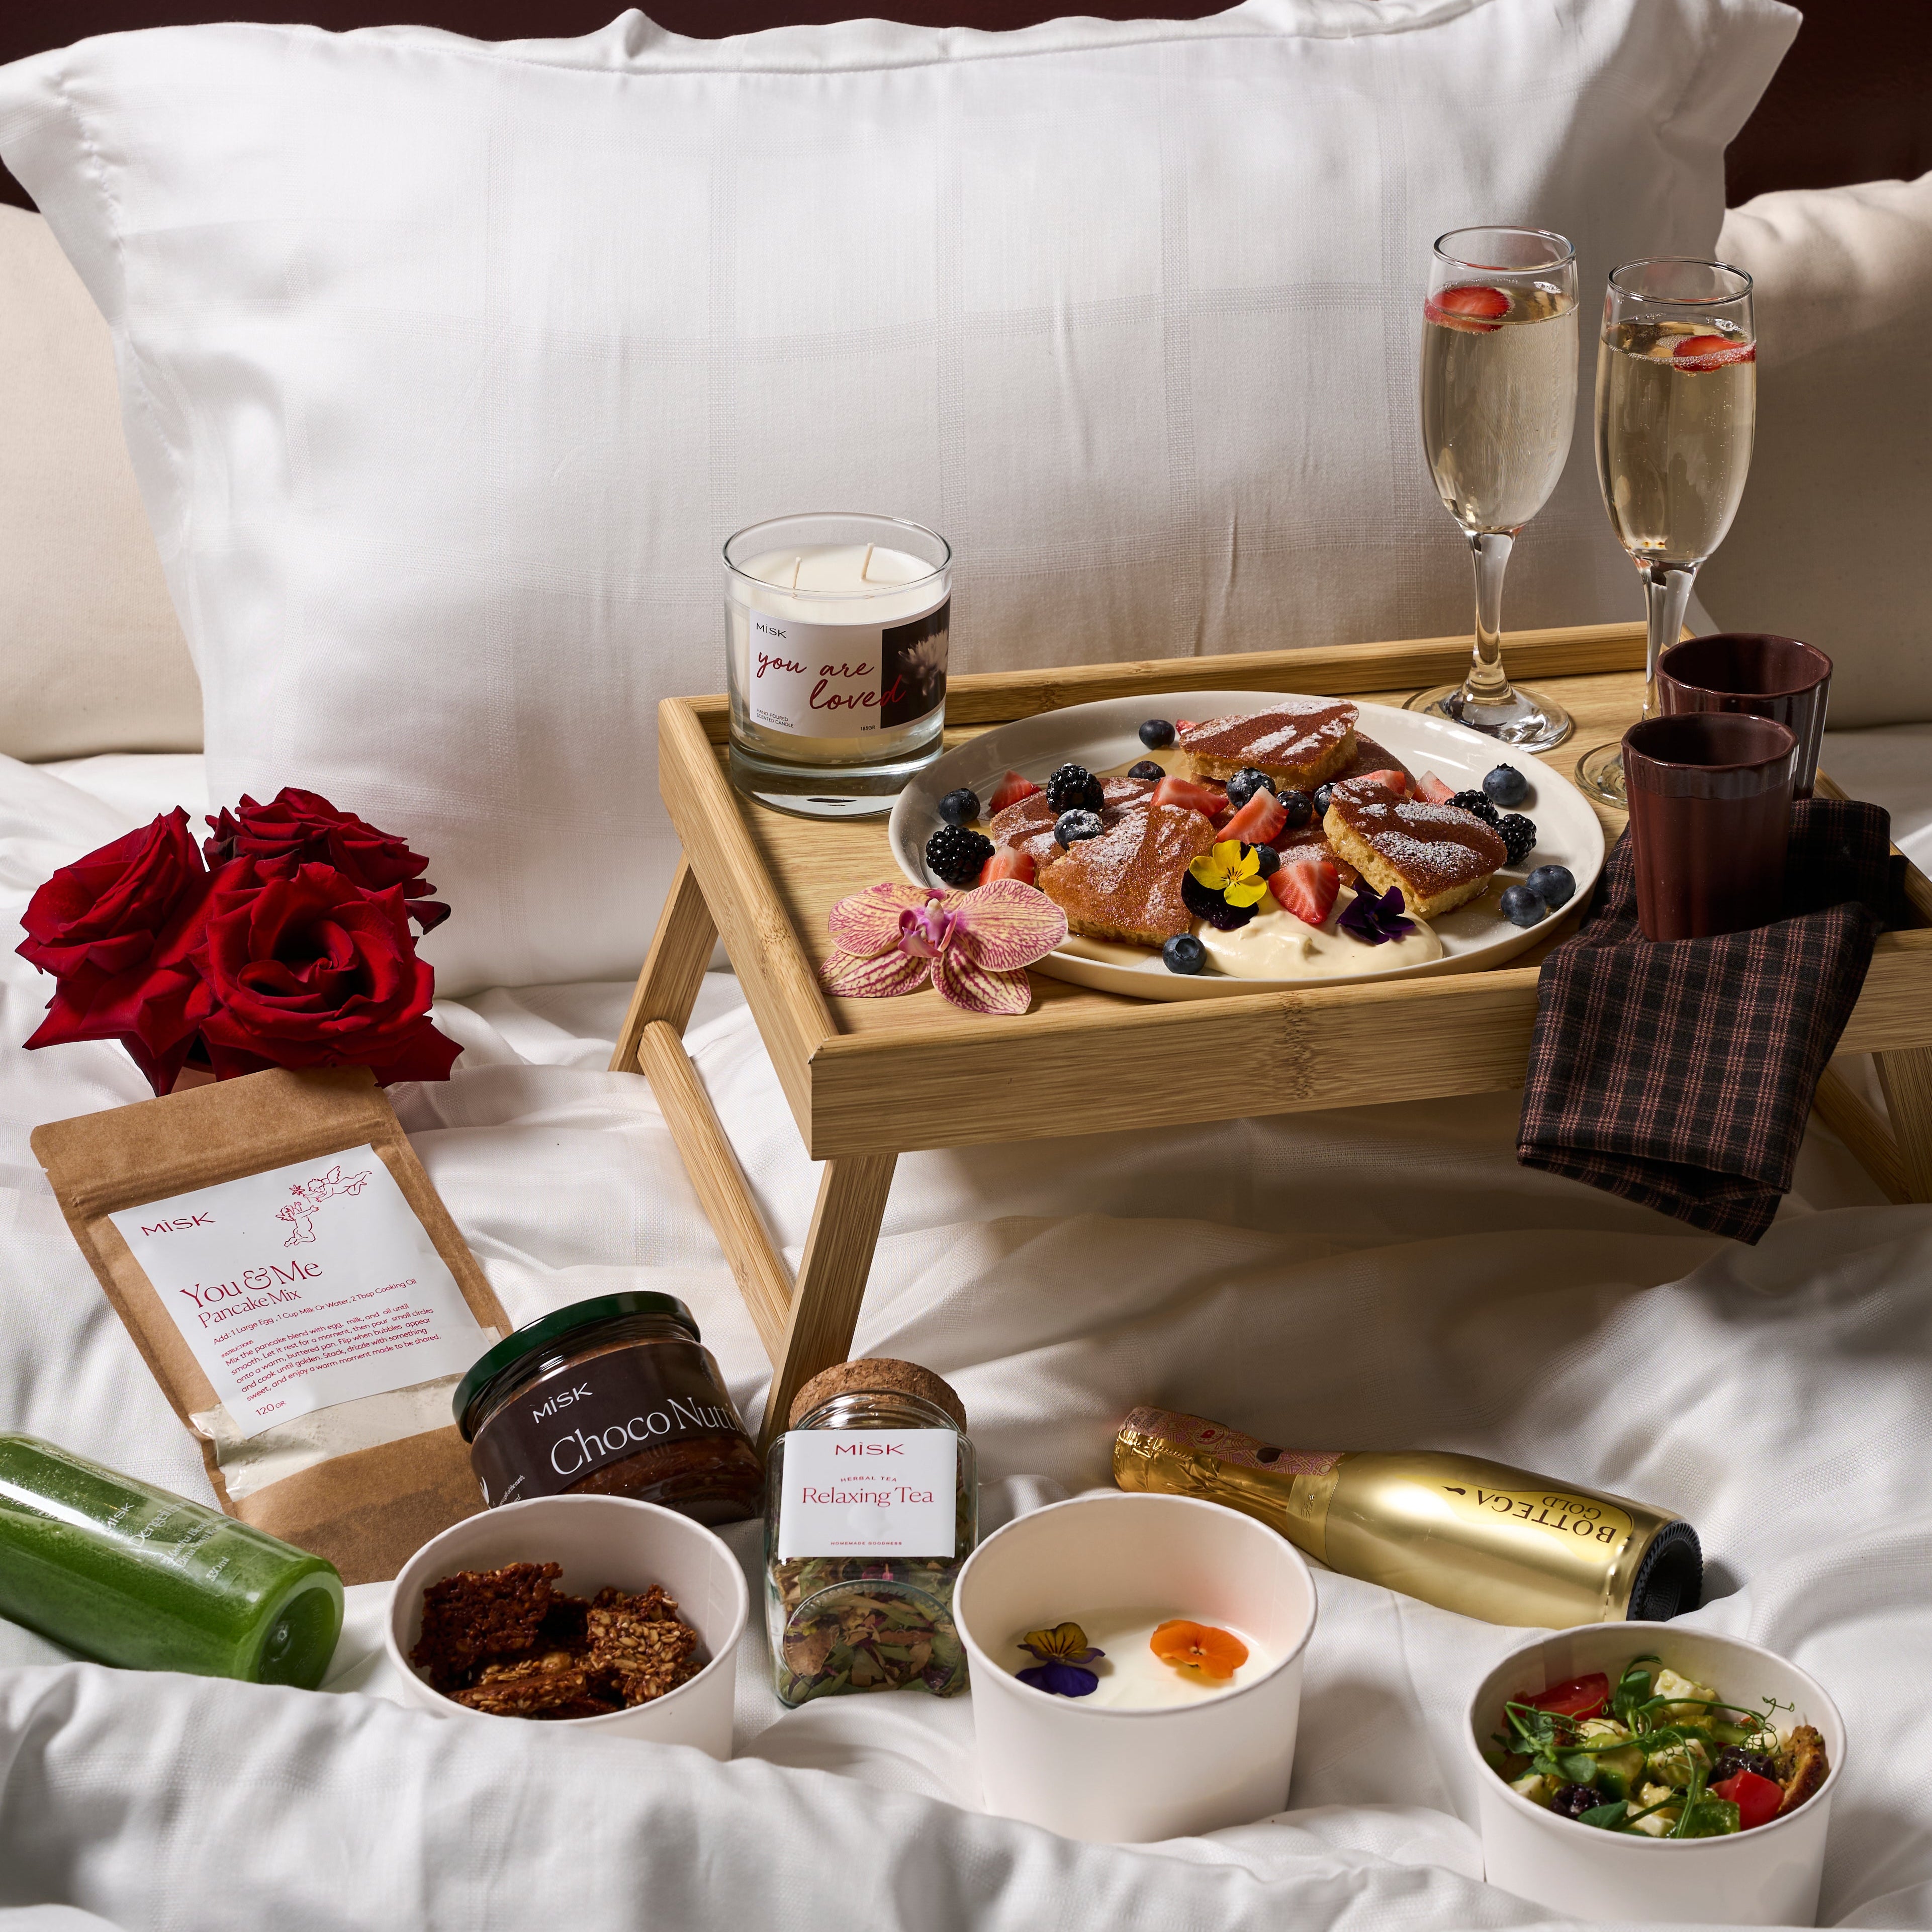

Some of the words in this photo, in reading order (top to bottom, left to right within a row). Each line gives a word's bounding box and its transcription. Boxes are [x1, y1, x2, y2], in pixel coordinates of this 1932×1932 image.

[756, 652, 807, 678] you
[819, 662, 875, 678] are
[756, 708, 788, 721] HAND-POURED
[809, 675, 906, 710] loved
[756, 713, 775, 723] SCENTED
[775, 720, 794, 728] CANDLE
[179, 1281, 243, 1309] You
[243, 1267, 271, 1290] &
[268, 1260, 323, 1285] Me
[198, 1297, 269, 1329] Pancake
[266, 1289, 302, 1304] Mix
[214, 1332, 231, 1345] Add:
[236, 1323, 258, 1333] Large
[325, 1299, 351, 1308] Water,
[355, 1292, 375, 1300] Tbsp
[375, 1282, 406, 1294] Cooking
[221, 1340, 254, 1358] INSTRUCTIONS
[225, 1356, 240, 1366] Mix
[239, 1350, 254, 1358] the
[254, 1337, 287, 1354] pancake
[287, 1330, 309, 1340] blend
[346, 1317, 364, 1325] milk,
[365, 1311, 380, 1320] and
[392, 1303, 409, 1312] until
[231, 1357, 263, 1375] smooth.
[262, 1350, 276, 1359] Let
[284, 1343, 298, 1351] rest
[318, 1329, 352, 1341] moment,
[371, 1319, 388, 1328] pour
[391, 1312, 411, 1322] small
[236, 1371, 254, 1384] onto
[261, 1357, 287, 1370] warm,
[286, 1345, 320, 1359] buttered
[321, 1342, 338, 1351] pan.
[352, 1332, 374, 1341] when
[375, 1325, 402, 1335] bubbles
[405, 1318, 430, 1328] appear
[242, 1379, 257, 1393] and
[258, 1370, 277, 1384] cook
[277, 1362, 294, 1373] until
[295, 1355, 323, 1367] golden.
[322, 1349, 346, 1359] Stack,
[347, 1342, 371, 1352] drizzle
[371, 1337, 388, 1345] with
[388, 1328, 428, 1341] something
[246, 1386, 271, 1402] sweet,
[272, 1375, 287, 1388] and
[288, 1368, 308, 1379] enjoy
[315, 1361, 338, 1369] warm
[339, 1351, 372, 1364] moment
[372, 1345, 394, 1355] made
[415, 1333, 441, 1344] shared.
[255, 1404, 274, 1416] 120
[551, 1412, 671, 1475] Choco
[802, 1487, 891, 1508] Relaxing
[894, 1487, 935, 1503] Tea
[1478, 1490, 1617, 1544] BOTTEGA
[1542, 1496, 1602, 1520] GOLD
